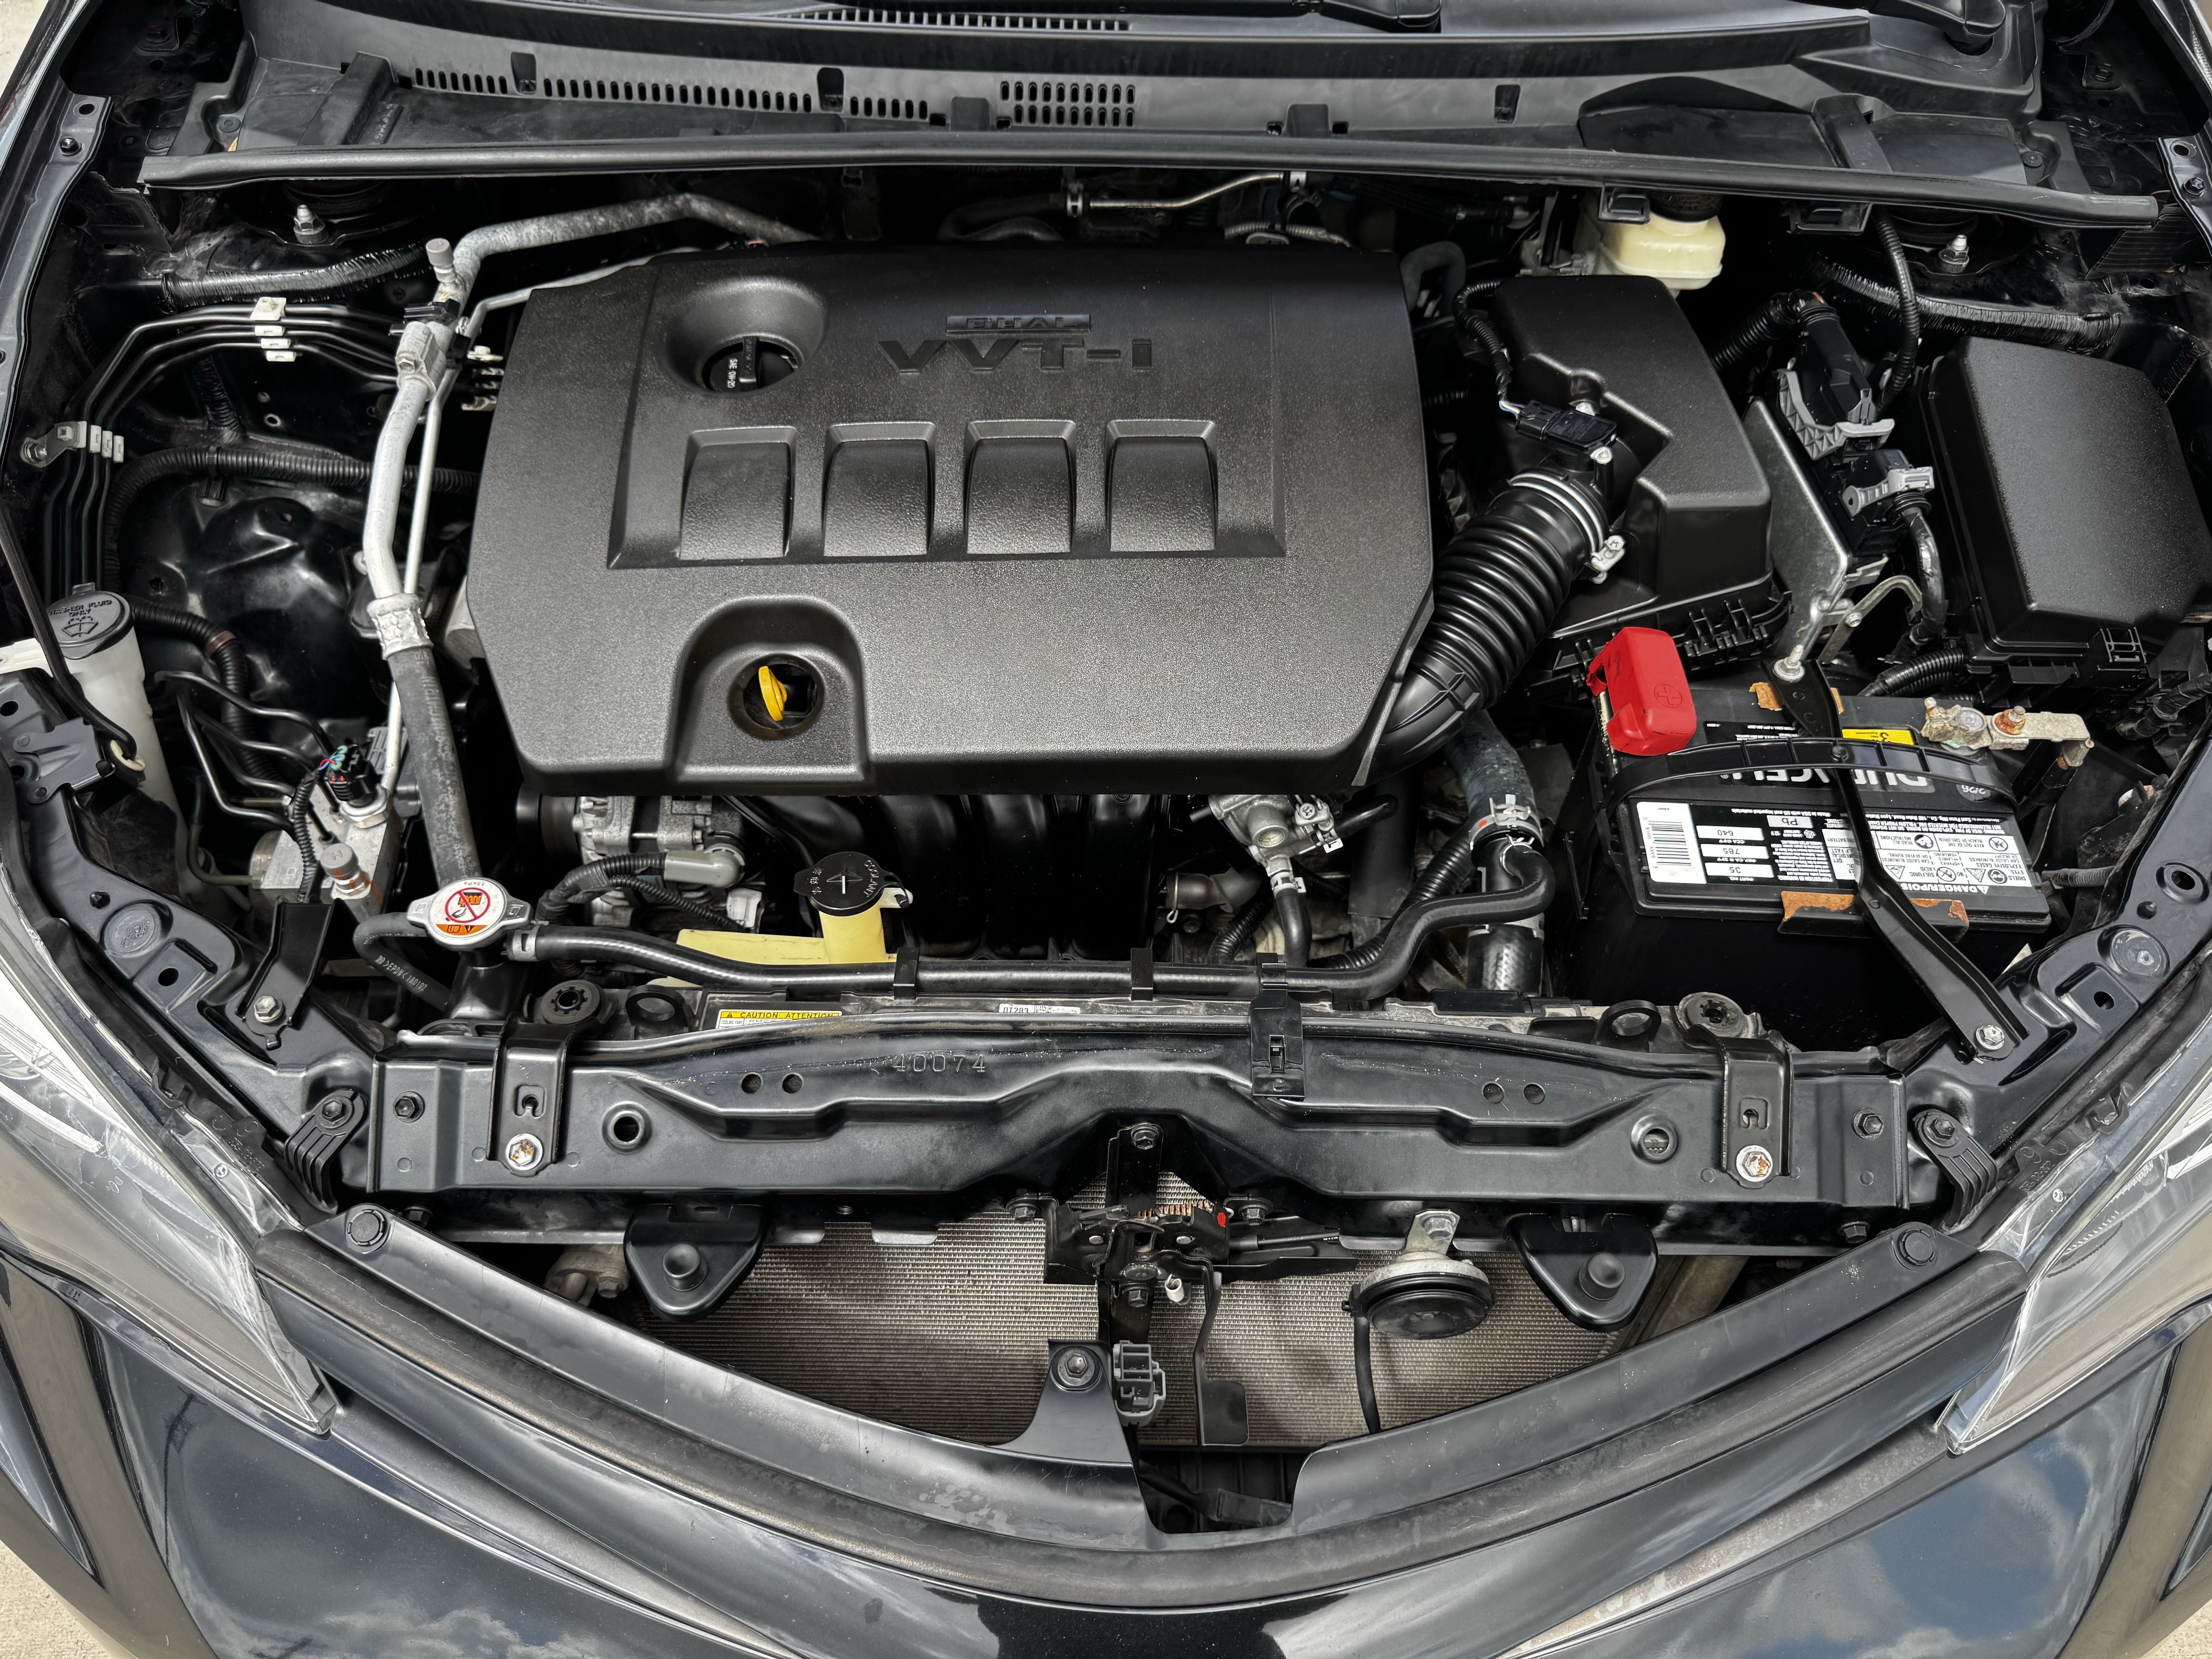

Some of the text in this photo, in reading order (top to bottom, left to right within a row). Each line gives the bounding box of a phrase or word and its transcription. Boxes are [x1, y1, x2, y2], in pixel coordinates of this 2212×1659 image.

[966, 317, 1077, 328] DUAL
[728, 357, 738, 369] SAE
[50, 605, 84, 615] WASHER
[69, 608, 91, 617] ONLY
[1881, 733, 1889, 742] 3
[1781, 818, 1798, 826] Pb
[864, 860, 879, 898] COOLANT
[893, 1054, 986, 1072] 40074
